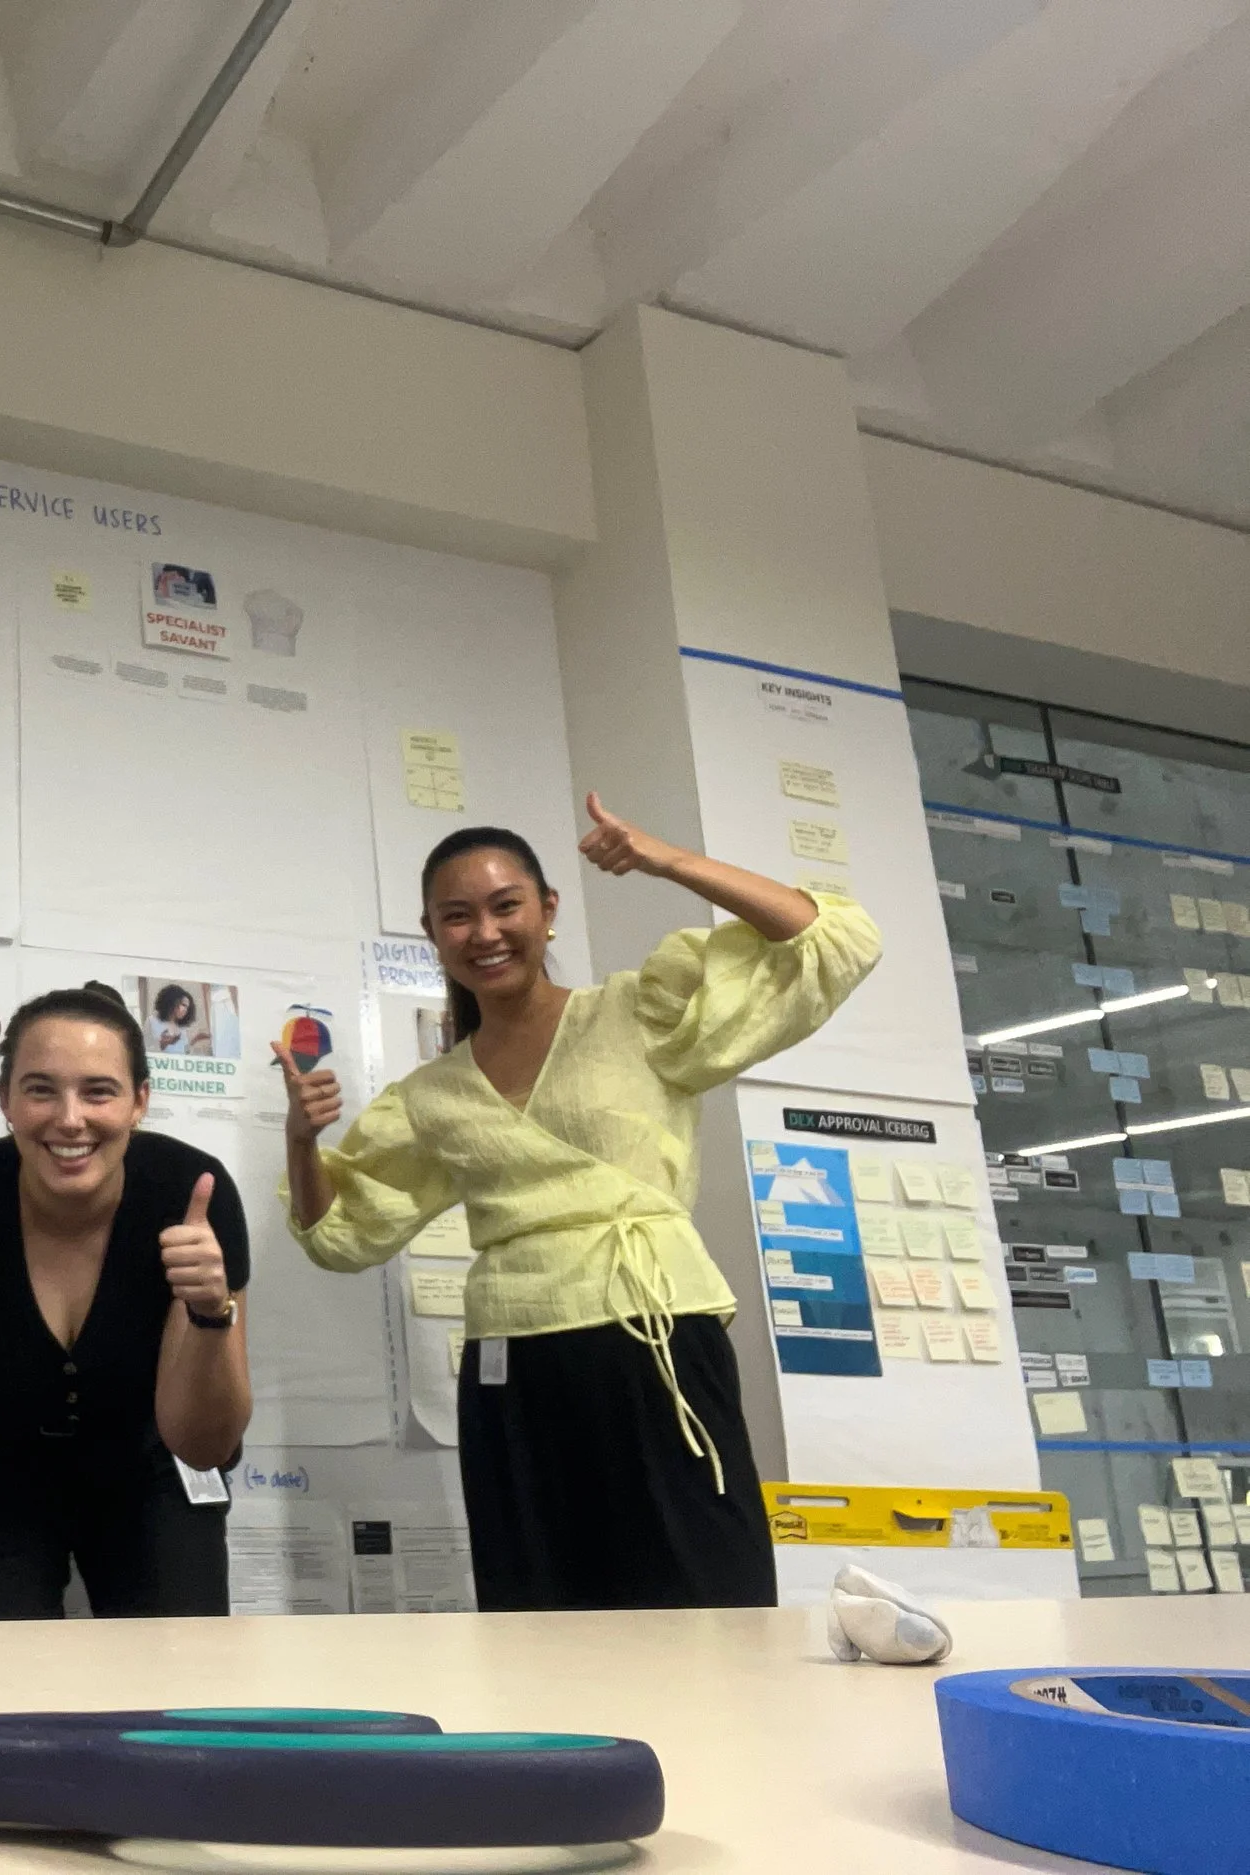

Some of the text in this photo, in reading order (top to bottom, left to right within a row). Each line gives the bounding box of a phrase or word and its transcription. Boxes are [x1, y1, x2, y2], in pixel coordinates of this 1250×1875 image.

[93, 505, 162, 536] USERS
[146, 612, 227, 638] SPECIALIST
[159, 630, 218, 652] SAVANT
[761, 682, 832, 706] KEY INSIGHTS
[146, 1056, 237, 1076] EWILDERED
[818, 1114, 883, 1135] APPROVAL
[884, 1120, 930, 1139] ICEBERG
